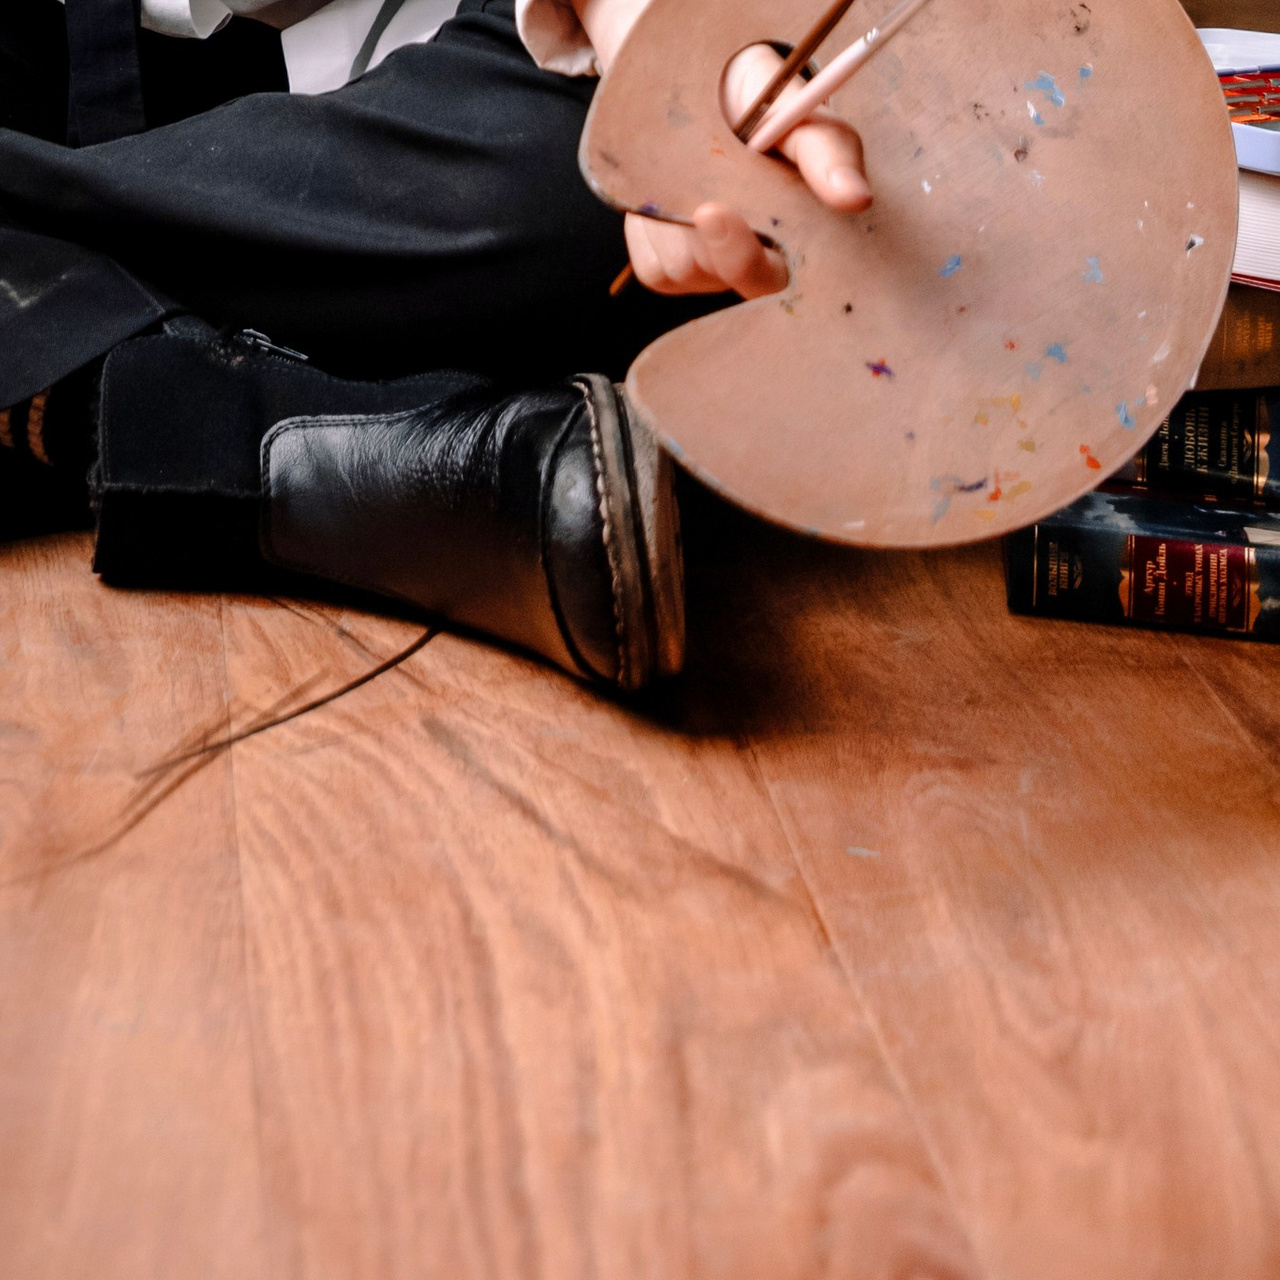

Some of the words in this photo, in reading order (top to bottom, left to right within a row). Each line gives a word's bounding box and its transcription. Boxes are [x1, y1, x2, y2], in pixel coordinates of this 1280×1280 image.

[1183, 408, 1197, 468] ЛЮБОВЬ
[1196, 406, 1210, 461] ЖИЗНИ
[1158, 443, 1171, 470] Джек
[1153, 542, 1167, 580] Дойль
[1193, 543, 1204, 572] ТОНАХ
[1218, 548, 1228, 584] ХОЛМСА
[1144, 560, 1158, 595] Артур
[1194, 574, 1204, 617] БАГРОВЫХ
[1208, 553, 1218, 618] ПРИКЛЮЧЕНИЯ
[1155, 581, 1167, 616] Конан
